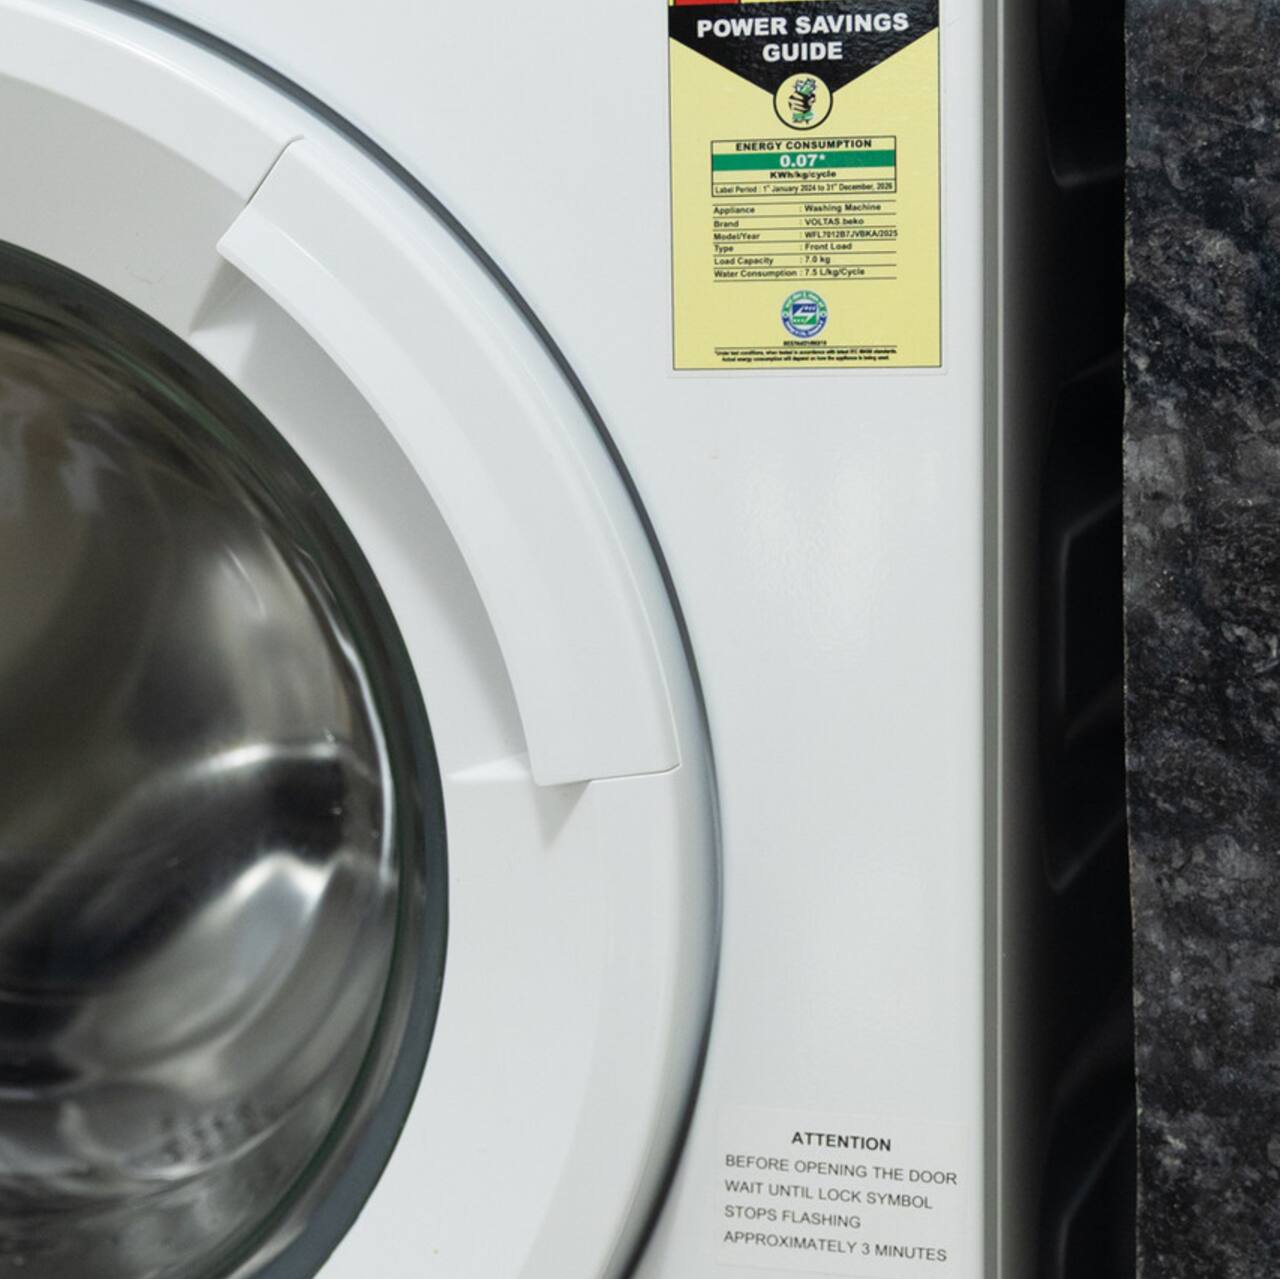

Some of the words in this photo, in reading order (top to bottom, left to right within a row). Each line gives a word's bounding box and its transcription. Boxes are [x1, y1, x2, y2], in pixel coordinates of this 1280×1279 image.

[697, 17, 788, 38] POWER
[795, 12, 909, 34] SAVINGS
[762, 41, 843, 62] GUIDE
[736, 142, 782, 151] ENERGY
[786, 139, 872, 150] CONSUMPTION
[713, 207, 755, 216] Appliance
[804, 204, 842, 213] Washing
[845, 203, 881, 211] Machine
[713, 220, 739, 228] Brand
[804, 217, 840, 226] VOLTAS
[714, 244, 734, 253] Type
[830, 242, 852, 250] Load
[714, 257, 735, 265] Load
[737, 256, 774, 266] Capacity
[714, 270, 738, 278] Water
[740, 269, 798, 279] Consumption
[791, 1131, 892, 1152] ATTENTION
[725, 1154, 789, 1172] BEFORE
[794, 1160, 868, 1179] OPENING
[872, 1166, 904, 1182] THE
[909, 1169, 957, 1186] DOOR
[724, 1179, 763, 1195] WAIT
[769, 1183, 813, 1200] UNTIL
[818, 1188, 862, 1204] LOCK
[866, 1192, 933, 1210] SYMBOL
[724, 1205, 777, 1222] STOPS
[782, 1210, 862, 1229] FLASHING
[723, 1231, 858, 1255] APPROXIMATELY
[862, 1243, 870, 1256] 3
[875, 1244, 948, 1262] MINUTES
